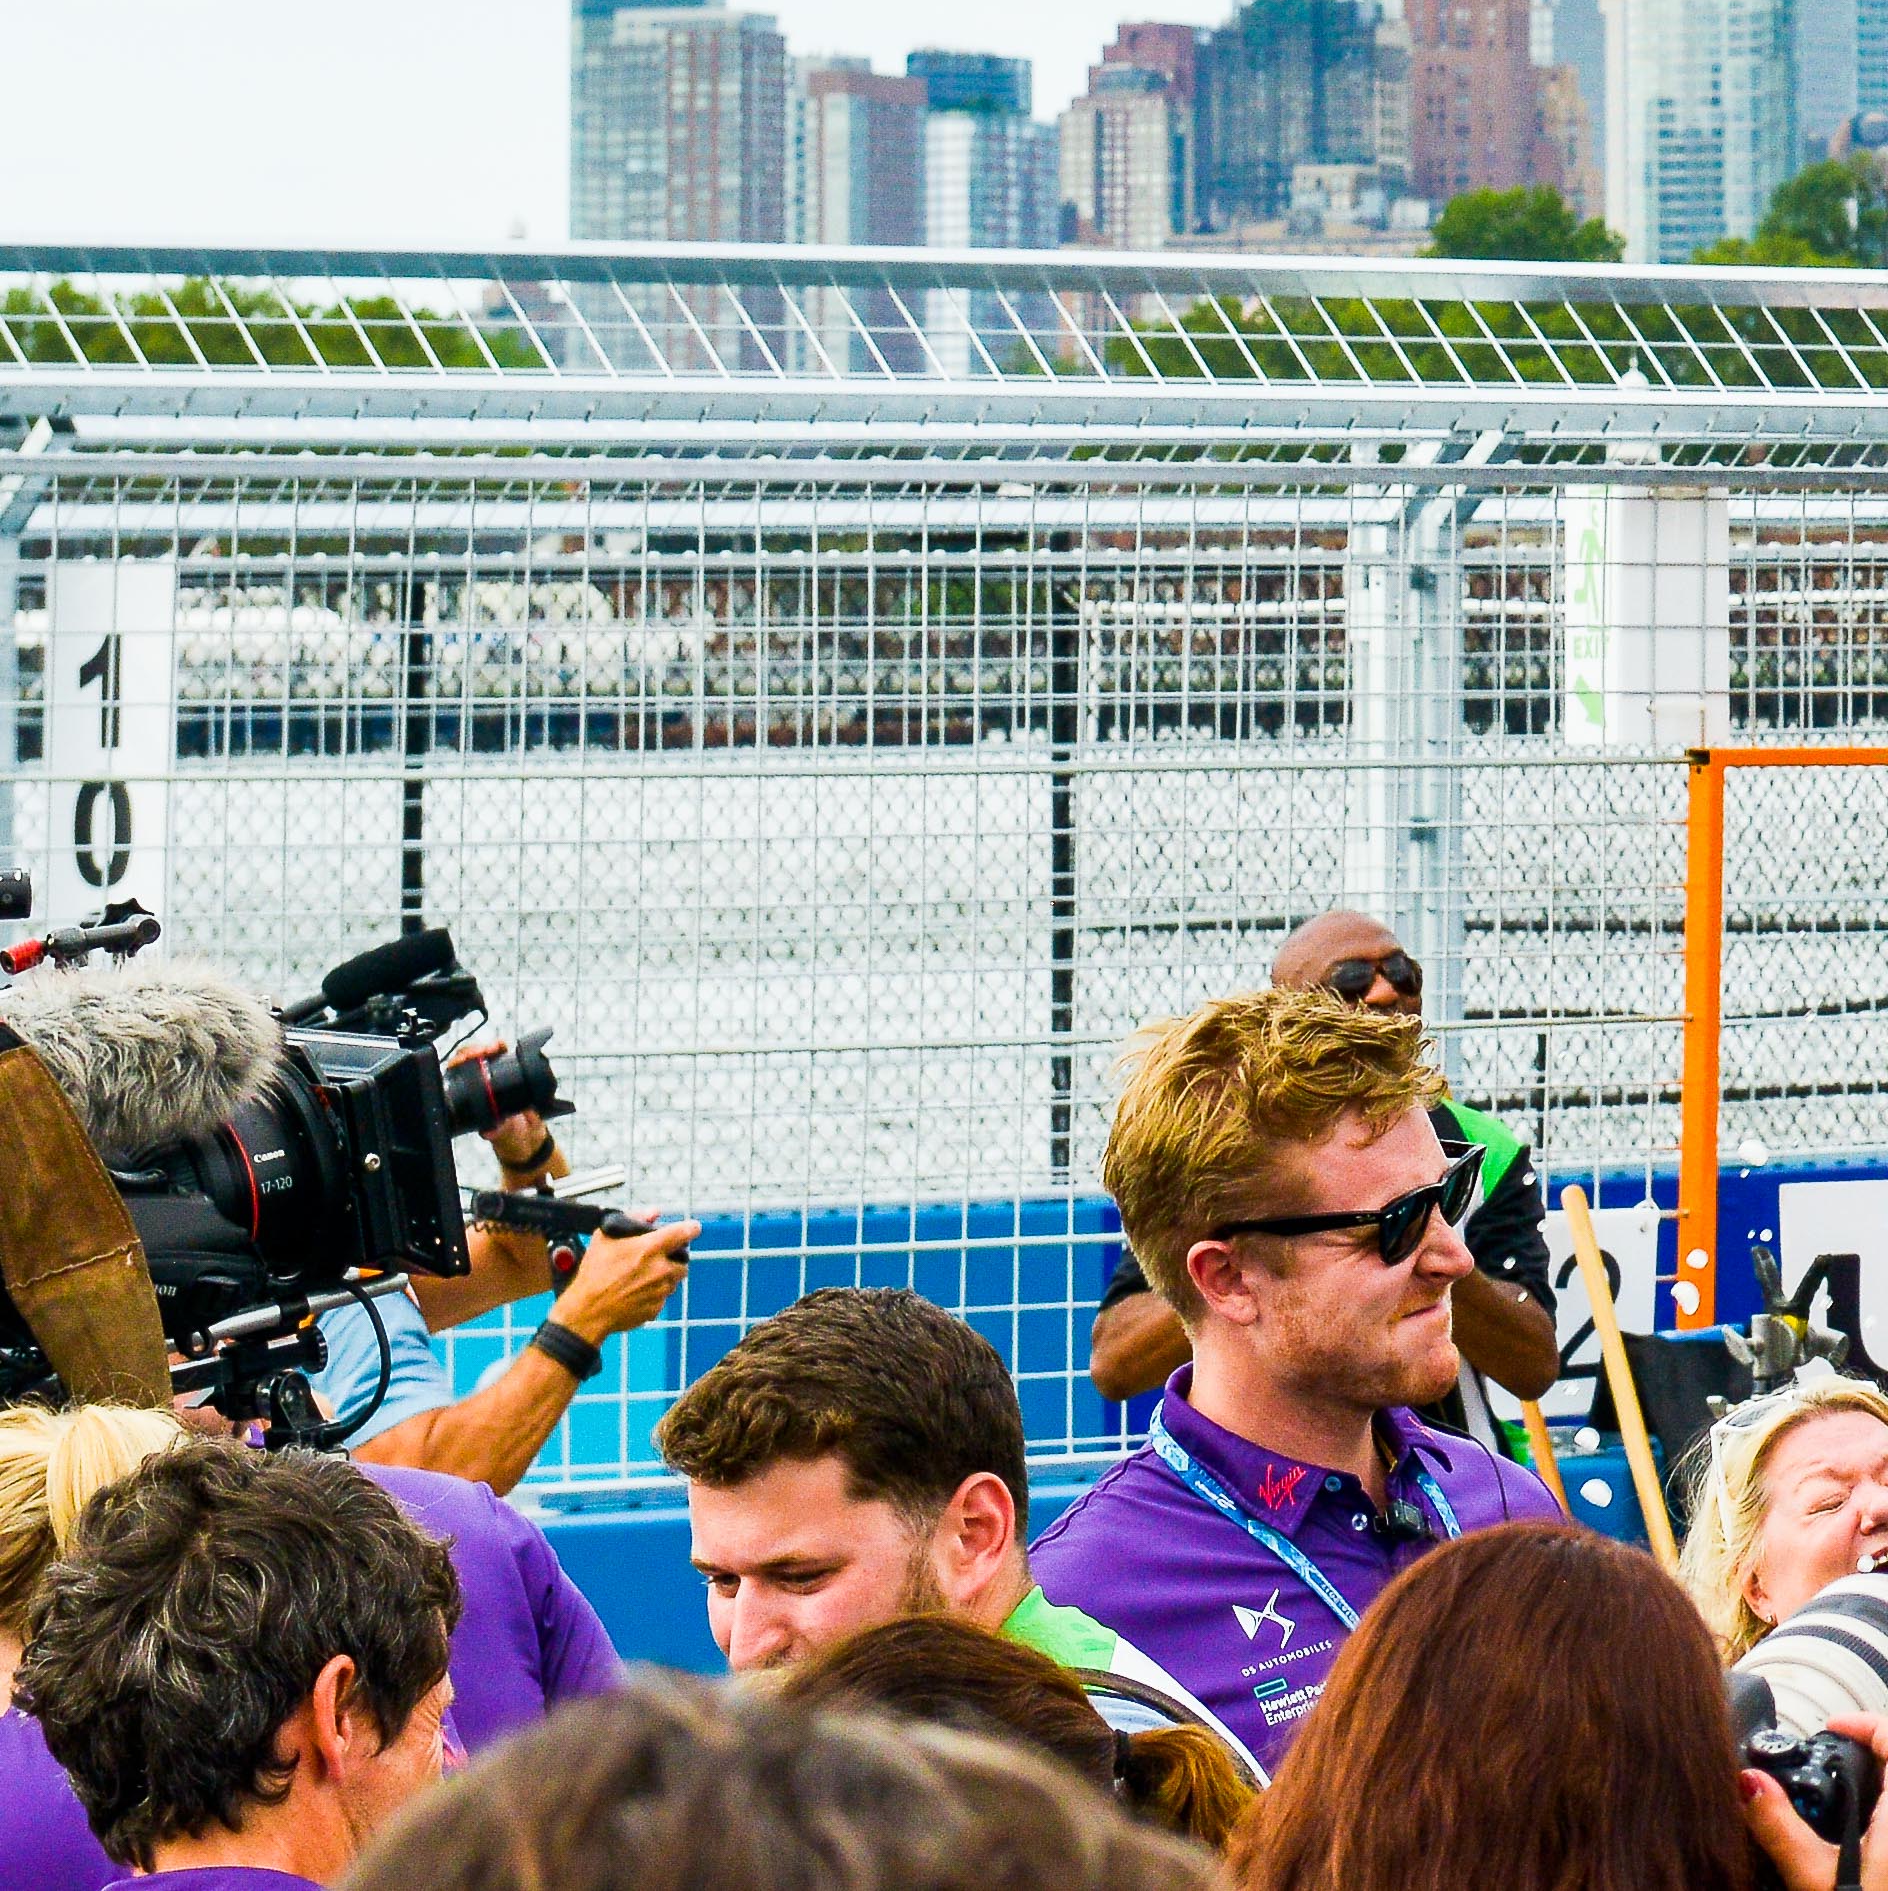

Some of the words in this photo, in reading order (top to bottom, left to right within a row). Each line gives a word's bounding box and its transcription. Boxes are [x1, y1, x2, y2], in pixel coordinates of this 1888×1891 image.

[1573, 635, 1611, 660] EXIT
[253, 1149, 286, 1164] Canon
[260, 1175, 293, 1195] 17-120
[1259, 1463, 1307, 1510] Virgin
[1241, 1666, 1257, 1678] DS
[1258, 1639, 1333, 1672] AUTOMOBILES
[1259, 1689, 1308, 1715] Hewlett
